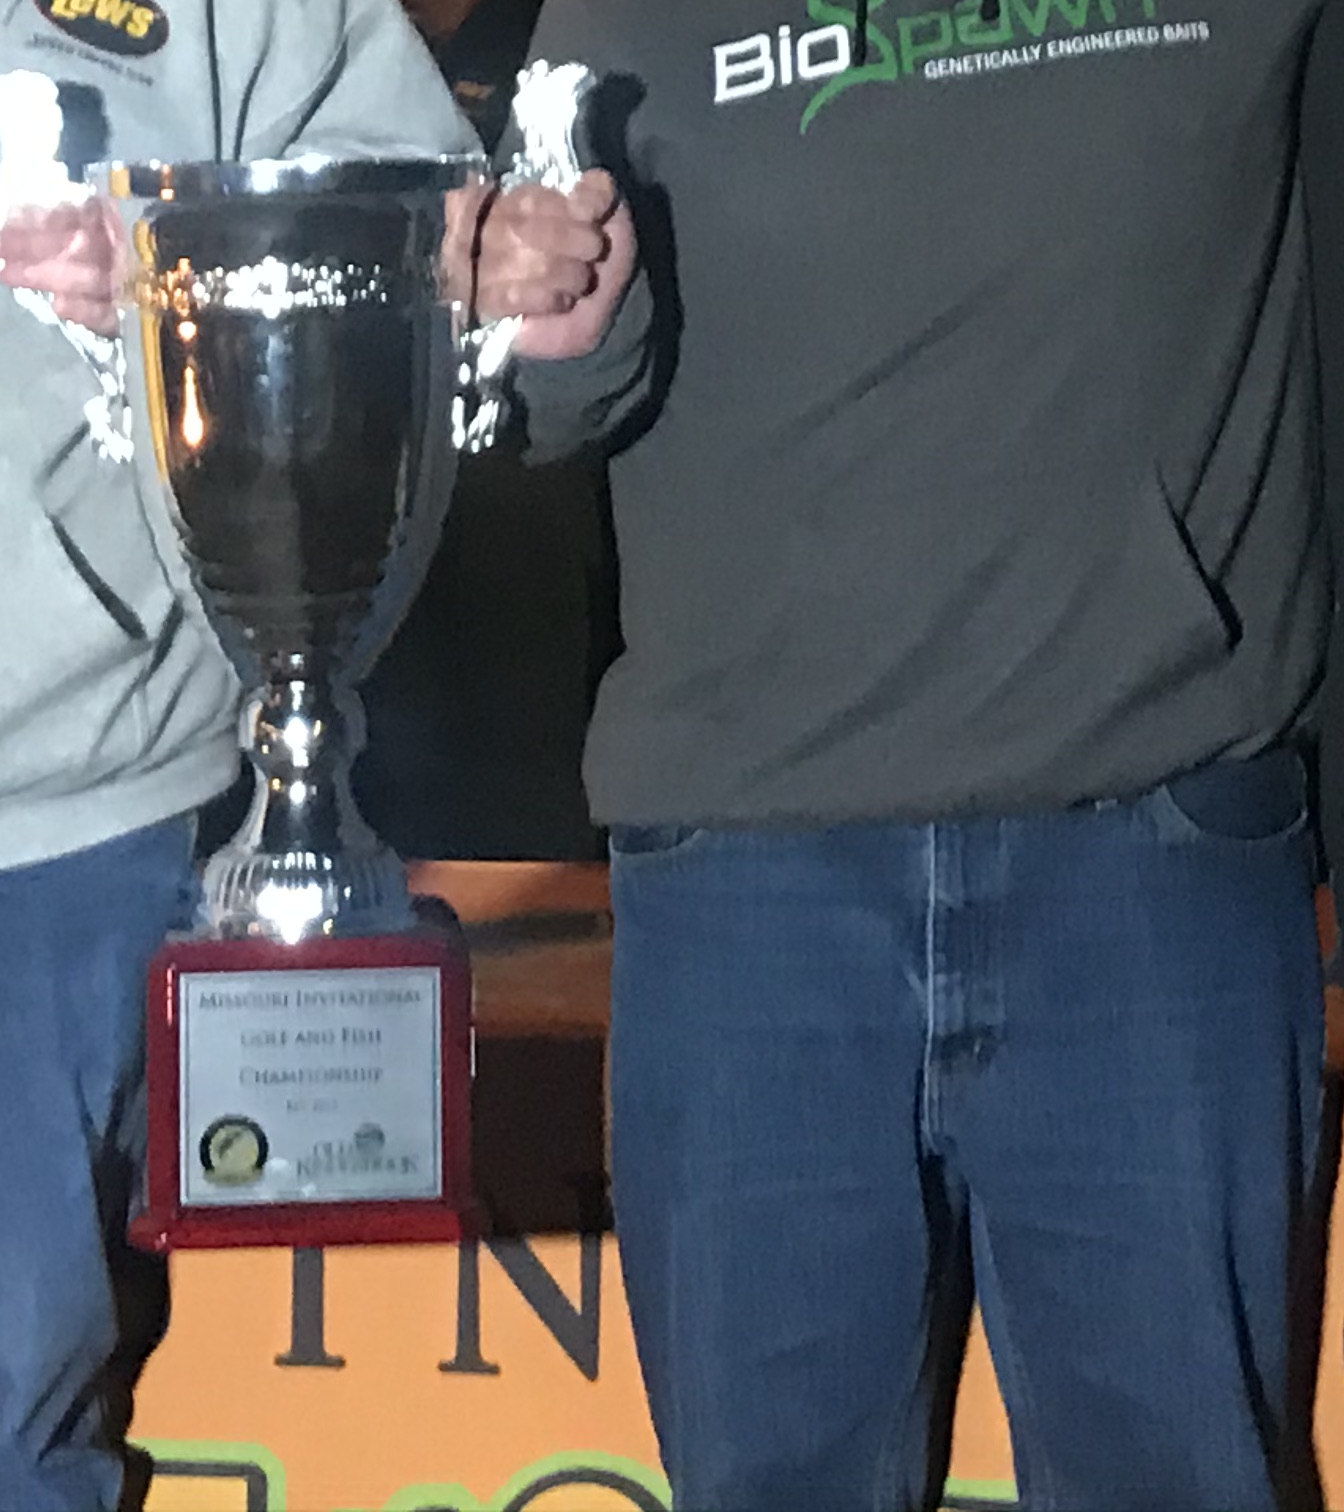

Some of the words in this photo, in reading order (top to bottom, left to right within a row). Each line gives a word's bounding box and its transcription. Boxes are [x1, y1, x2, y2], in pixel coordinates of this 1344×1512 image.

[924, 42, 1042, 81] GENETICALLY
[1047, 25, 1160, 59] ENGINEERED
[1163, 20, 1210, 42] BAITS
